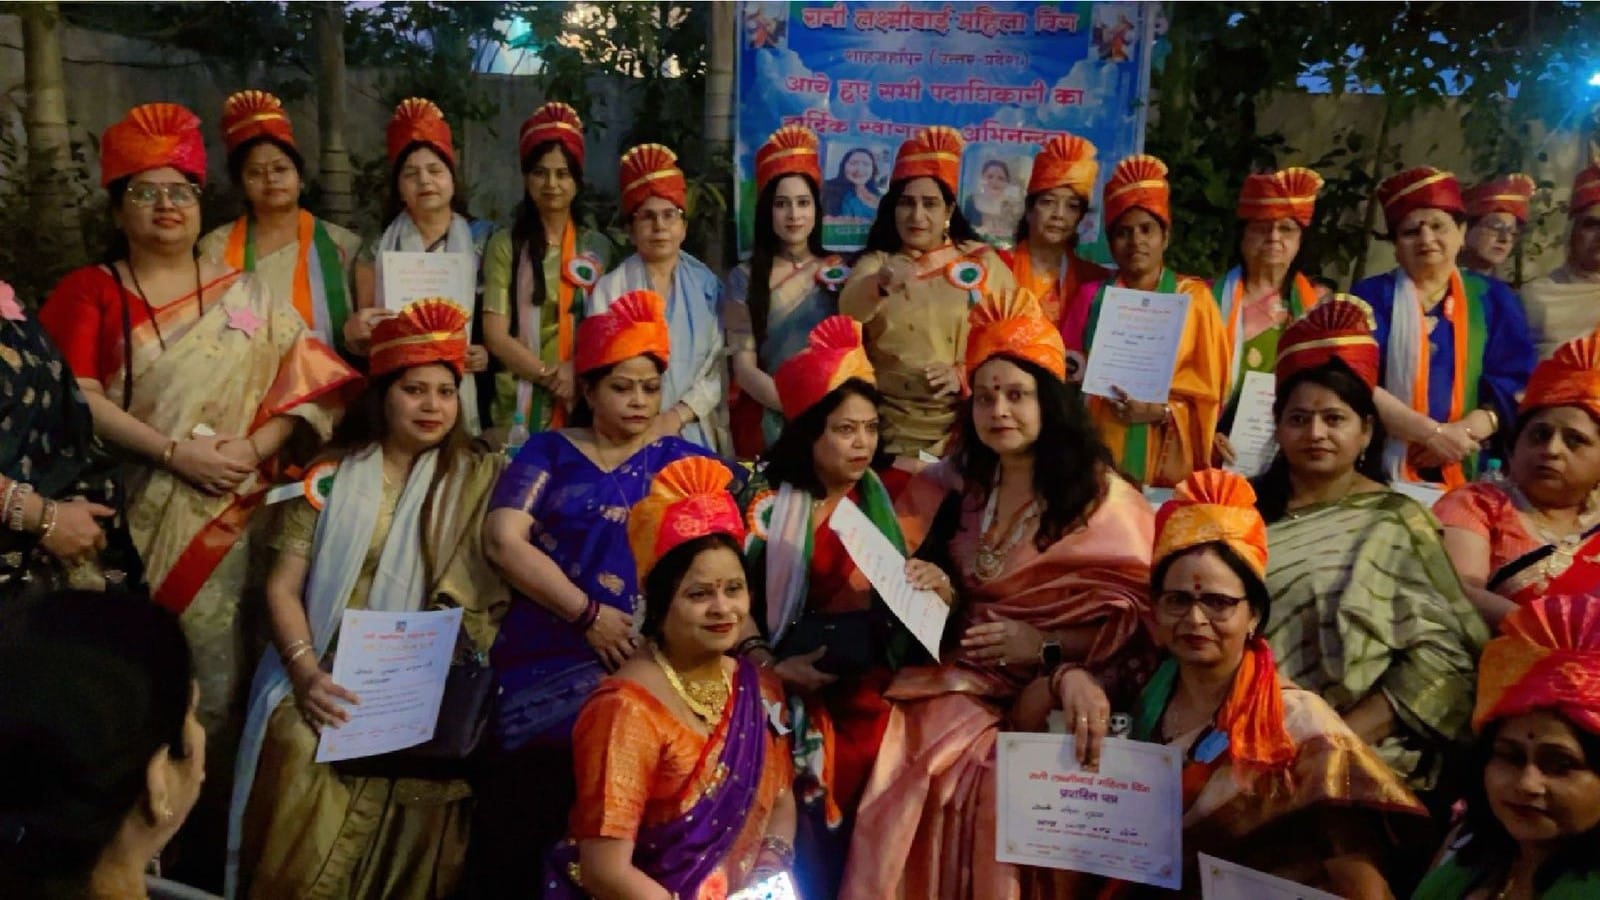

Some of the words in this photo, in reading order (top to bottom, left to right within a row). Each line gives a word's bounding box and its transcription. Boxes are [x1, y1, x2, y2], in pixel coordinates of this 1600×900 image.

[838, 79, 870, 104] हुए
[878, 76, 921, 101] सभी
[1053, 88, 1085, 106] का
[963, 119, 1069, 145] अभिनन्द
